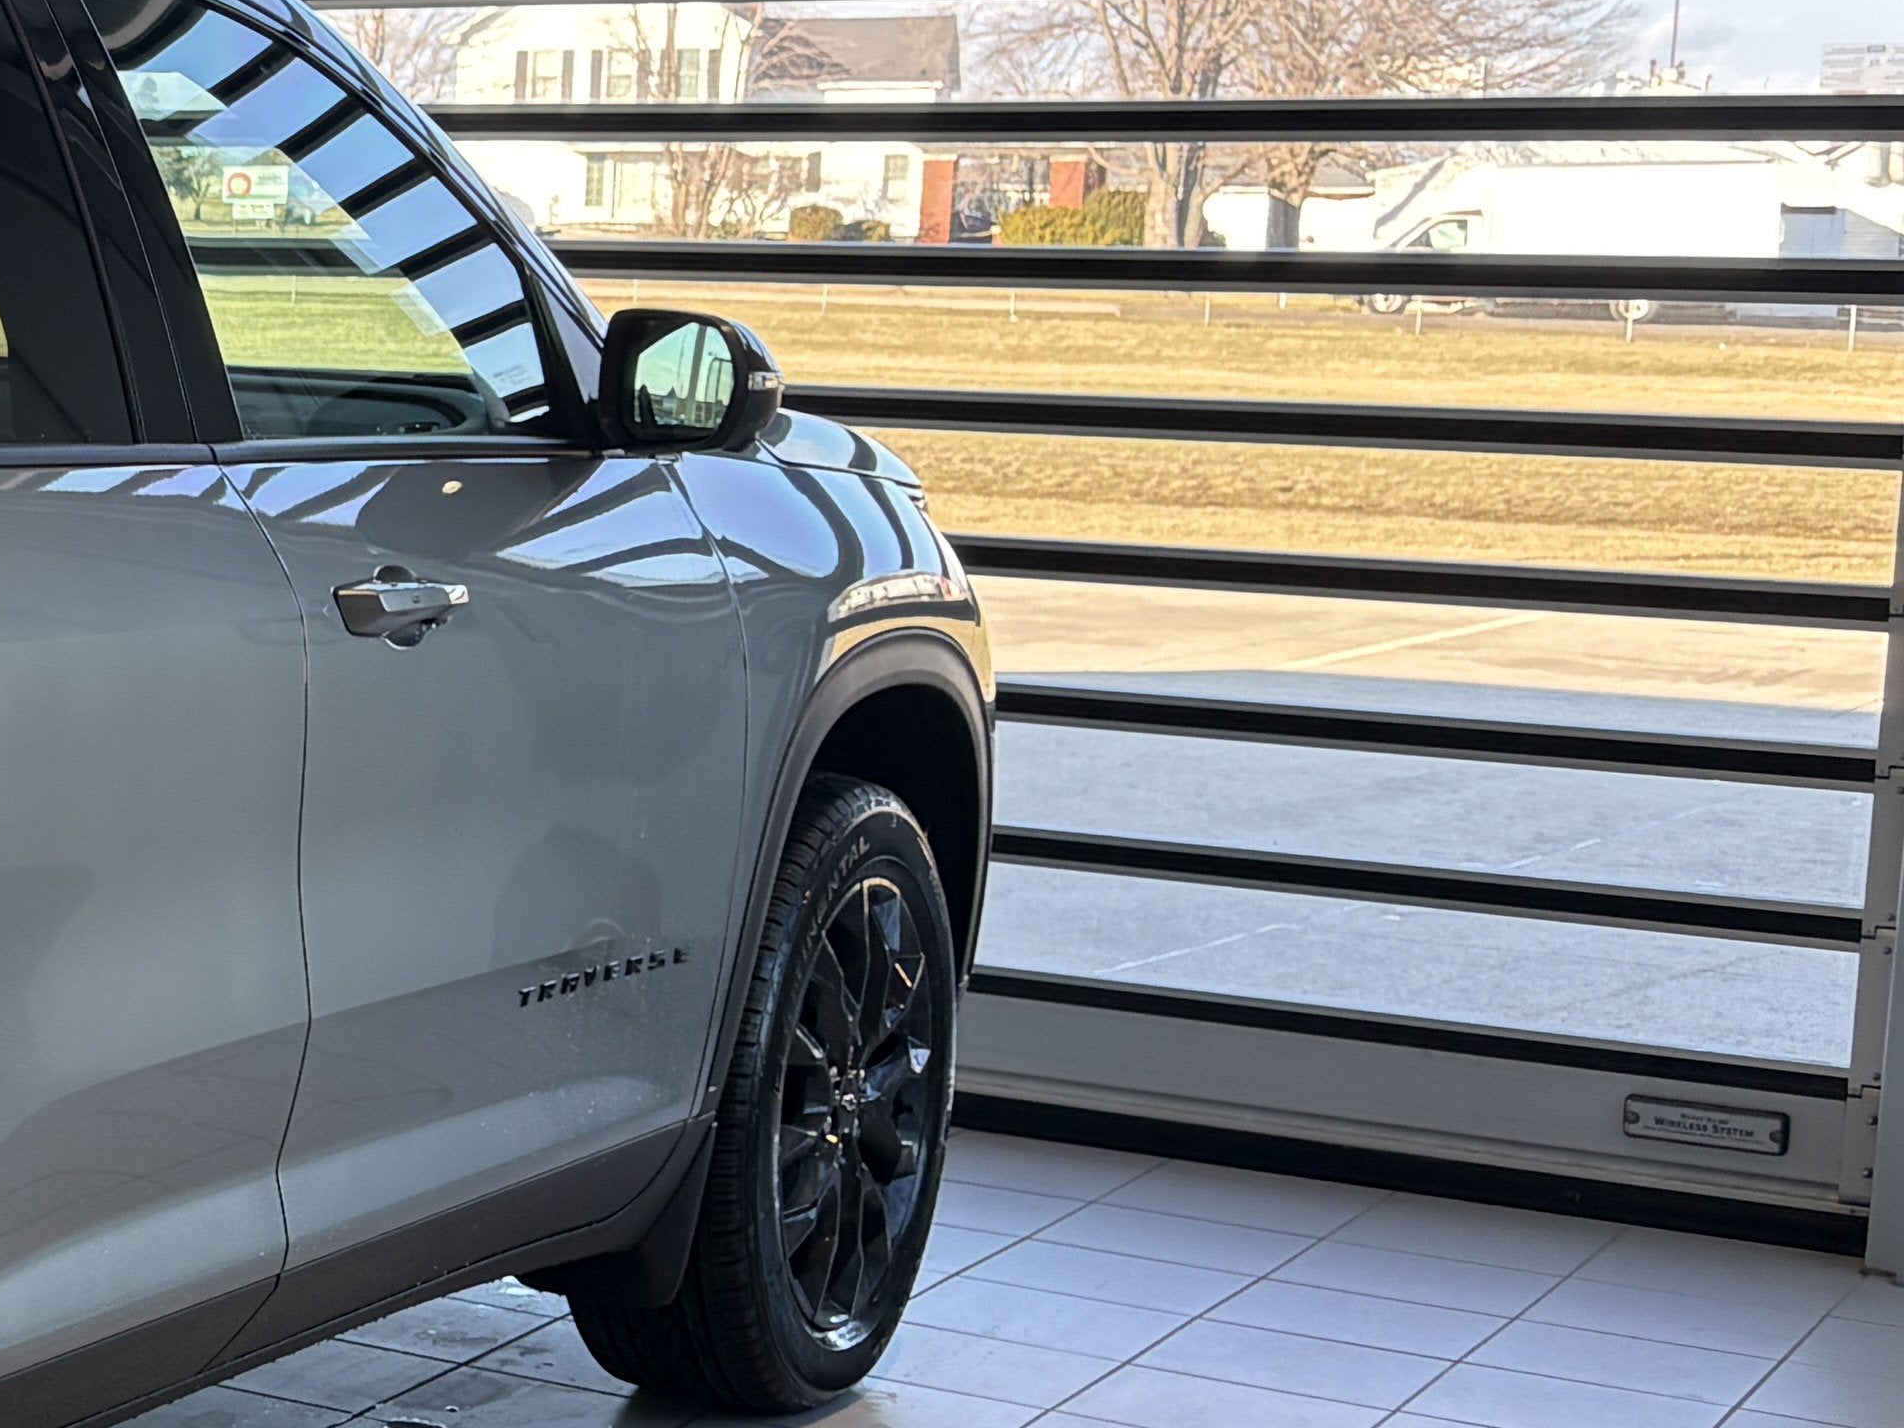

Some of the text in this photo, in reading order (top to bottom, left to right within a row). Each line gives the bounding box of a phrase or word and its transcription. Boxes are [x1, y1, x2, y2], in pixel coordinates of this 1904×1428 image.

[518, 947, 690, 1007] TRAVERSE
[1653, 1115, 1708, 1133] WIRELESS
[1712, 1123, 1755, 1138] SYSTEM
